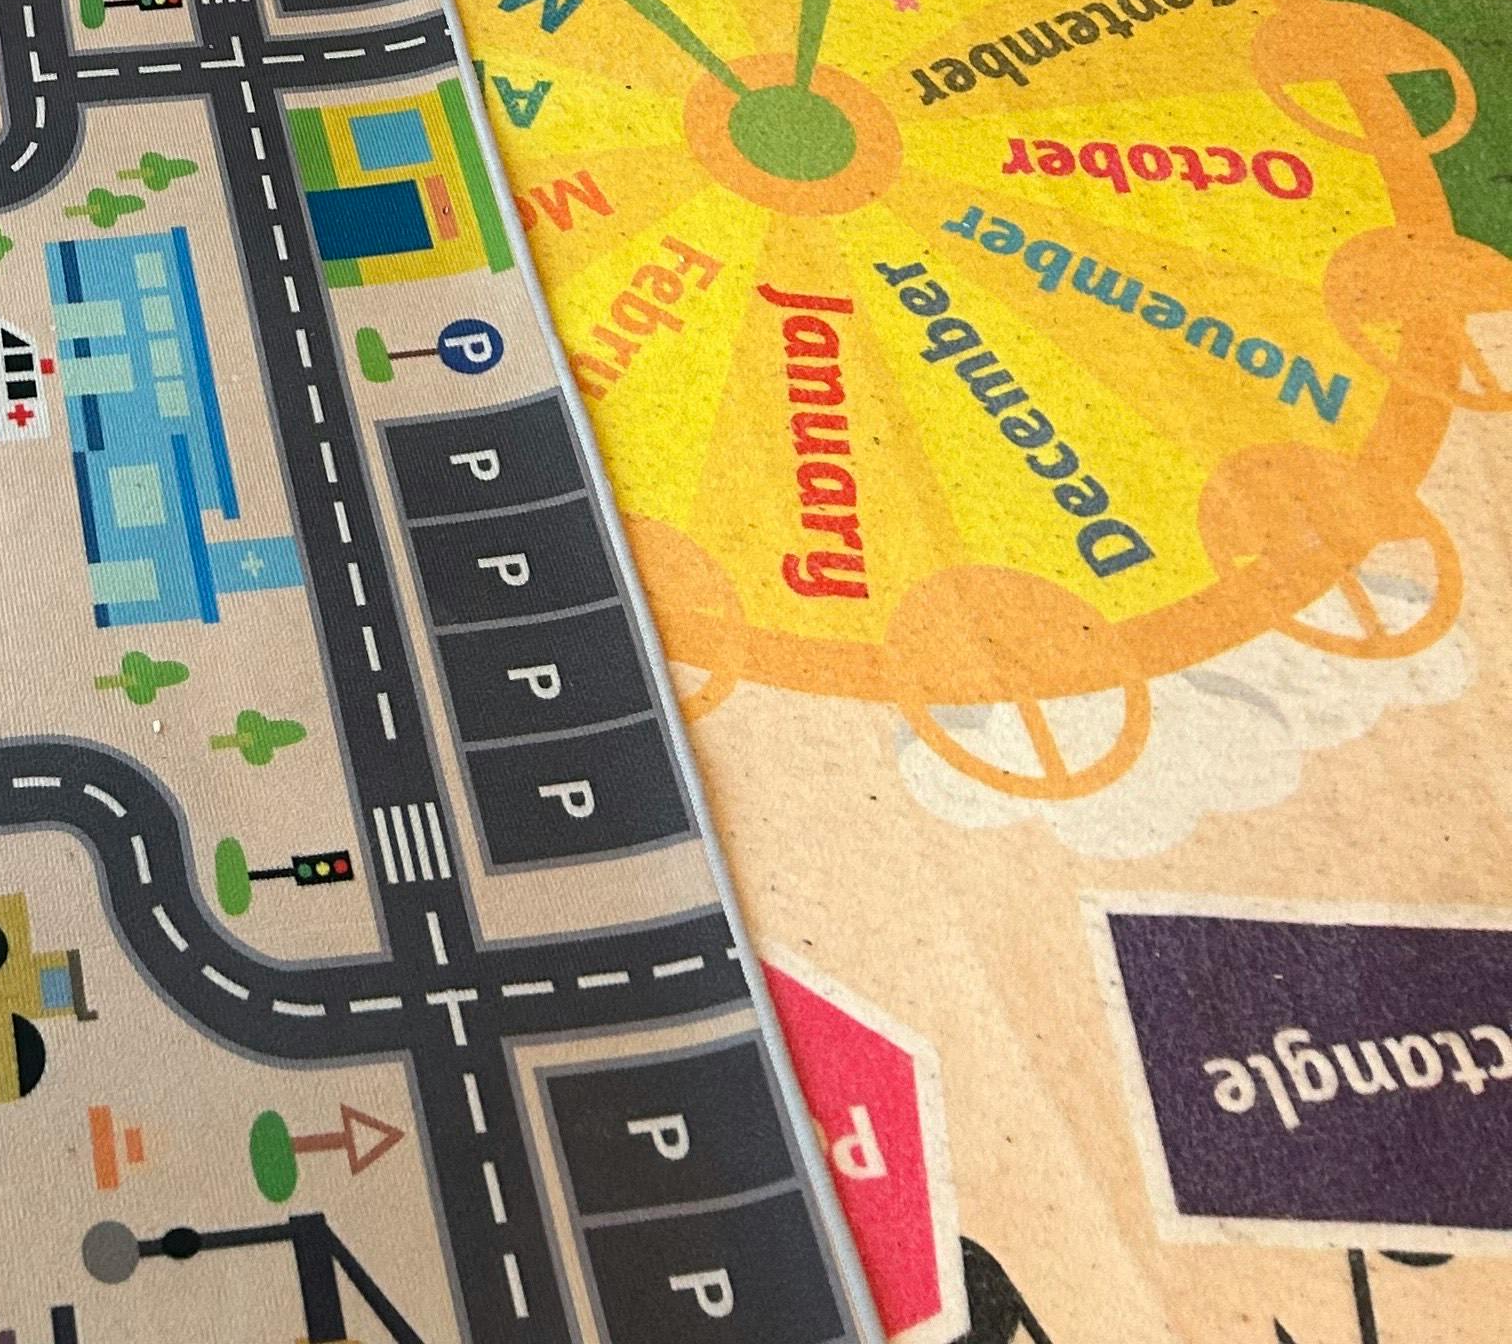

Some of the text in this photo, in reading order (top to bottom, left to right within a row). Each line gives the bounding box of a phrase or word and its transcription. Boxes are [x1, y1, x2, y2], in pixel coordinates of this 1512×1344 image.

[1001, 136, 1315, 200] October
[941, 204, 1353, 426] November
[447, 332, 494, 363] P
[756, 282, 869, 600] January
[872, 257, 1156, 579] December
[449, 448, 501, 482] P
[476, 553, 531, 588] P
[506, 663, 563, 699] P
[536, 781, 597, 819] P
[625, 1114, 692, 1160] P
[668, 1268, 735, 1317] P
